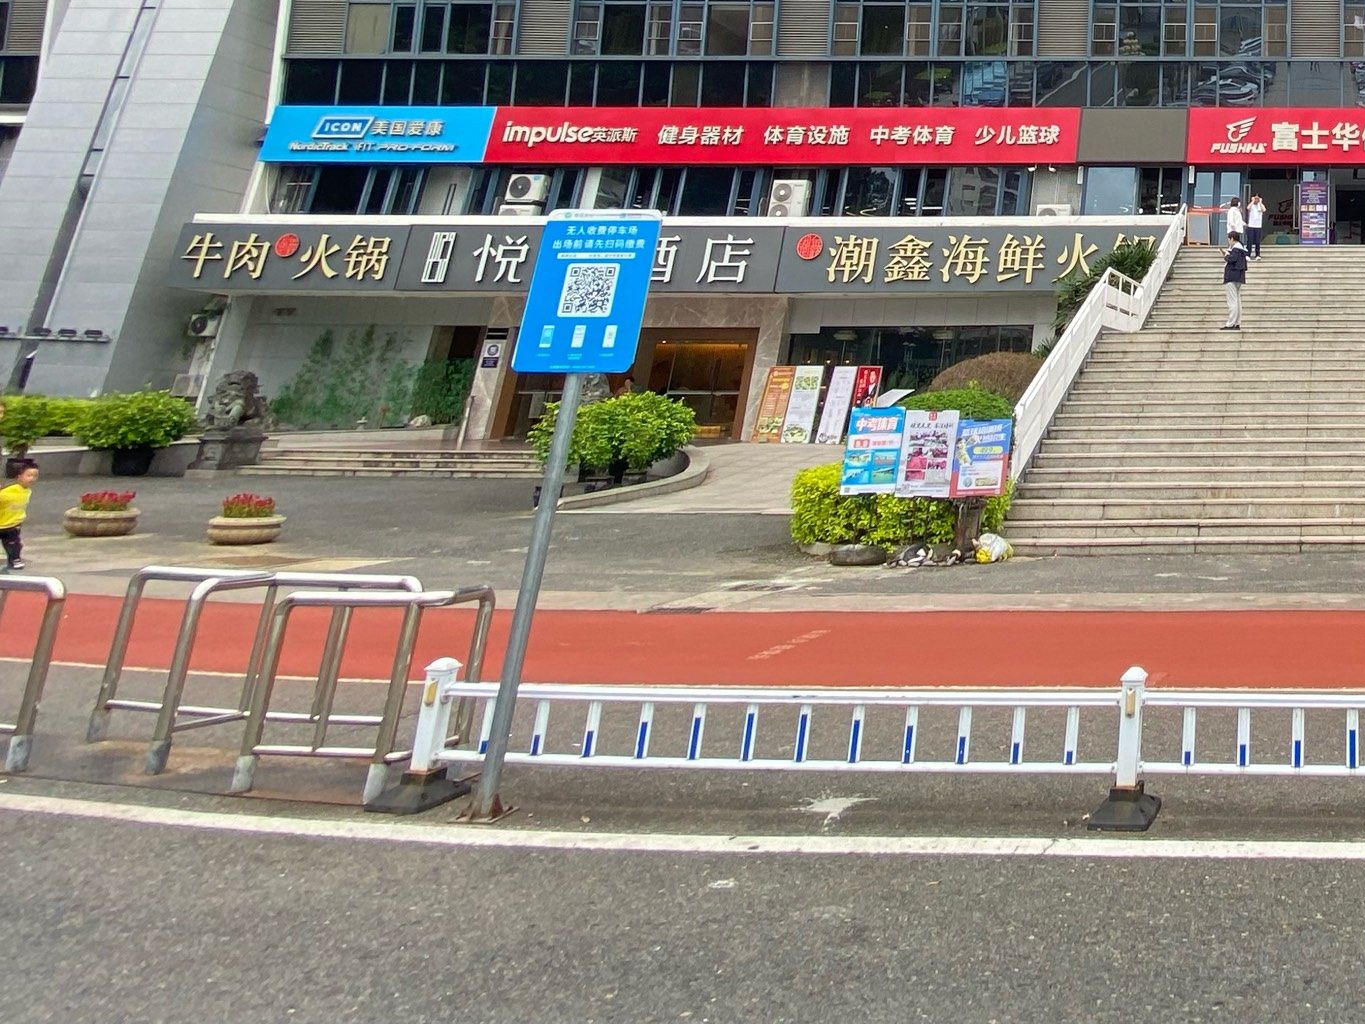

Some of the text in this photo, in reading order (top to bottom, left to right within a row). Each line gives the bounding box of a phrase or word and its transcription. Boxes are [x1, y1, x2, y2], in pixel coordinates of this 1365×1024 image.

[323, 120, 444, 137] ICON 美国爱康
[503, 121, 1061, 145] impulse 英派斯 健身器材 体育设施 中考体育 少儿篮球
[566, 225, 639, 236] 无人收费停车场
